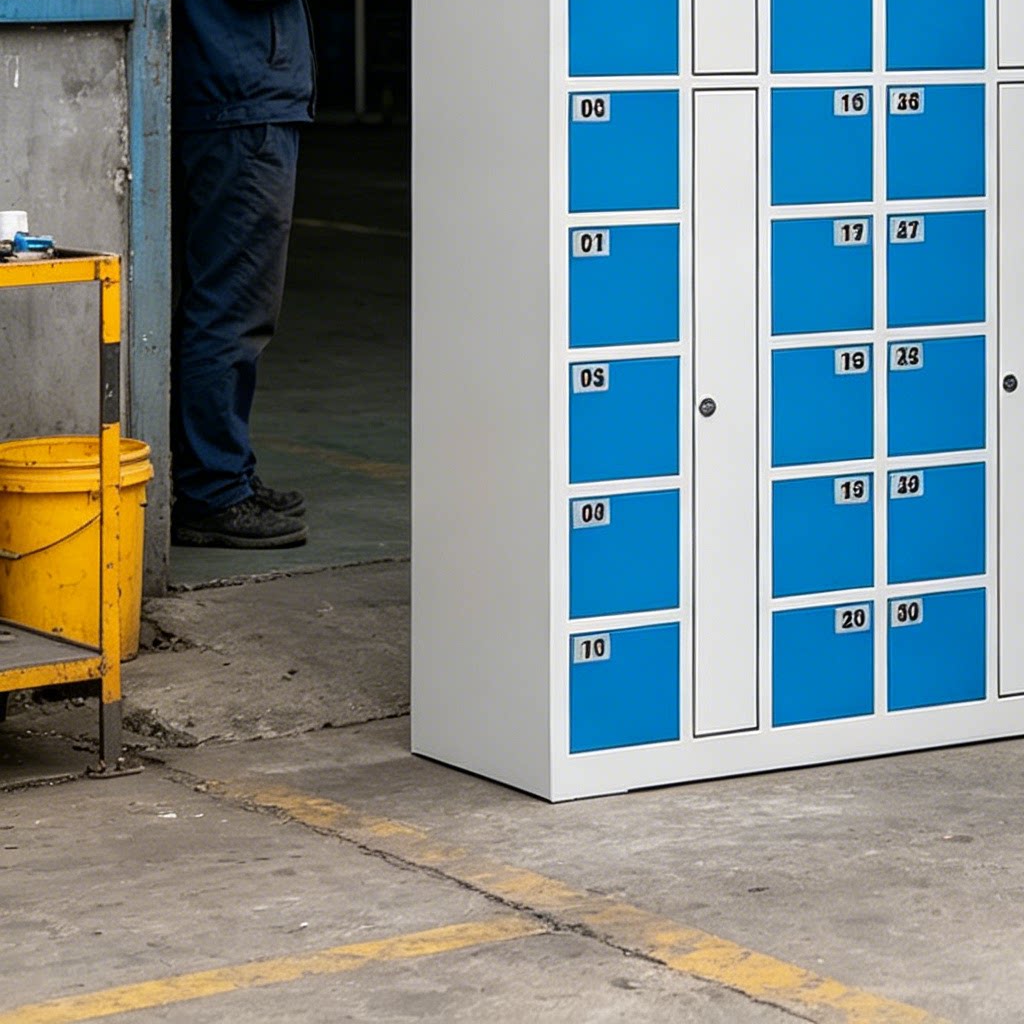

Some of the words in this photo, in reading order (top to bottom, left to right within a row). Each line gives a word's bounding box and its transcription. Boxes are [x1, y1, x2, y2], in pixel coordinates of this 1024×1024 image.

[580, 233, 603, 253] 01
[841, 608, 866, 629] 20
[581, 638, 605, 659] 10
